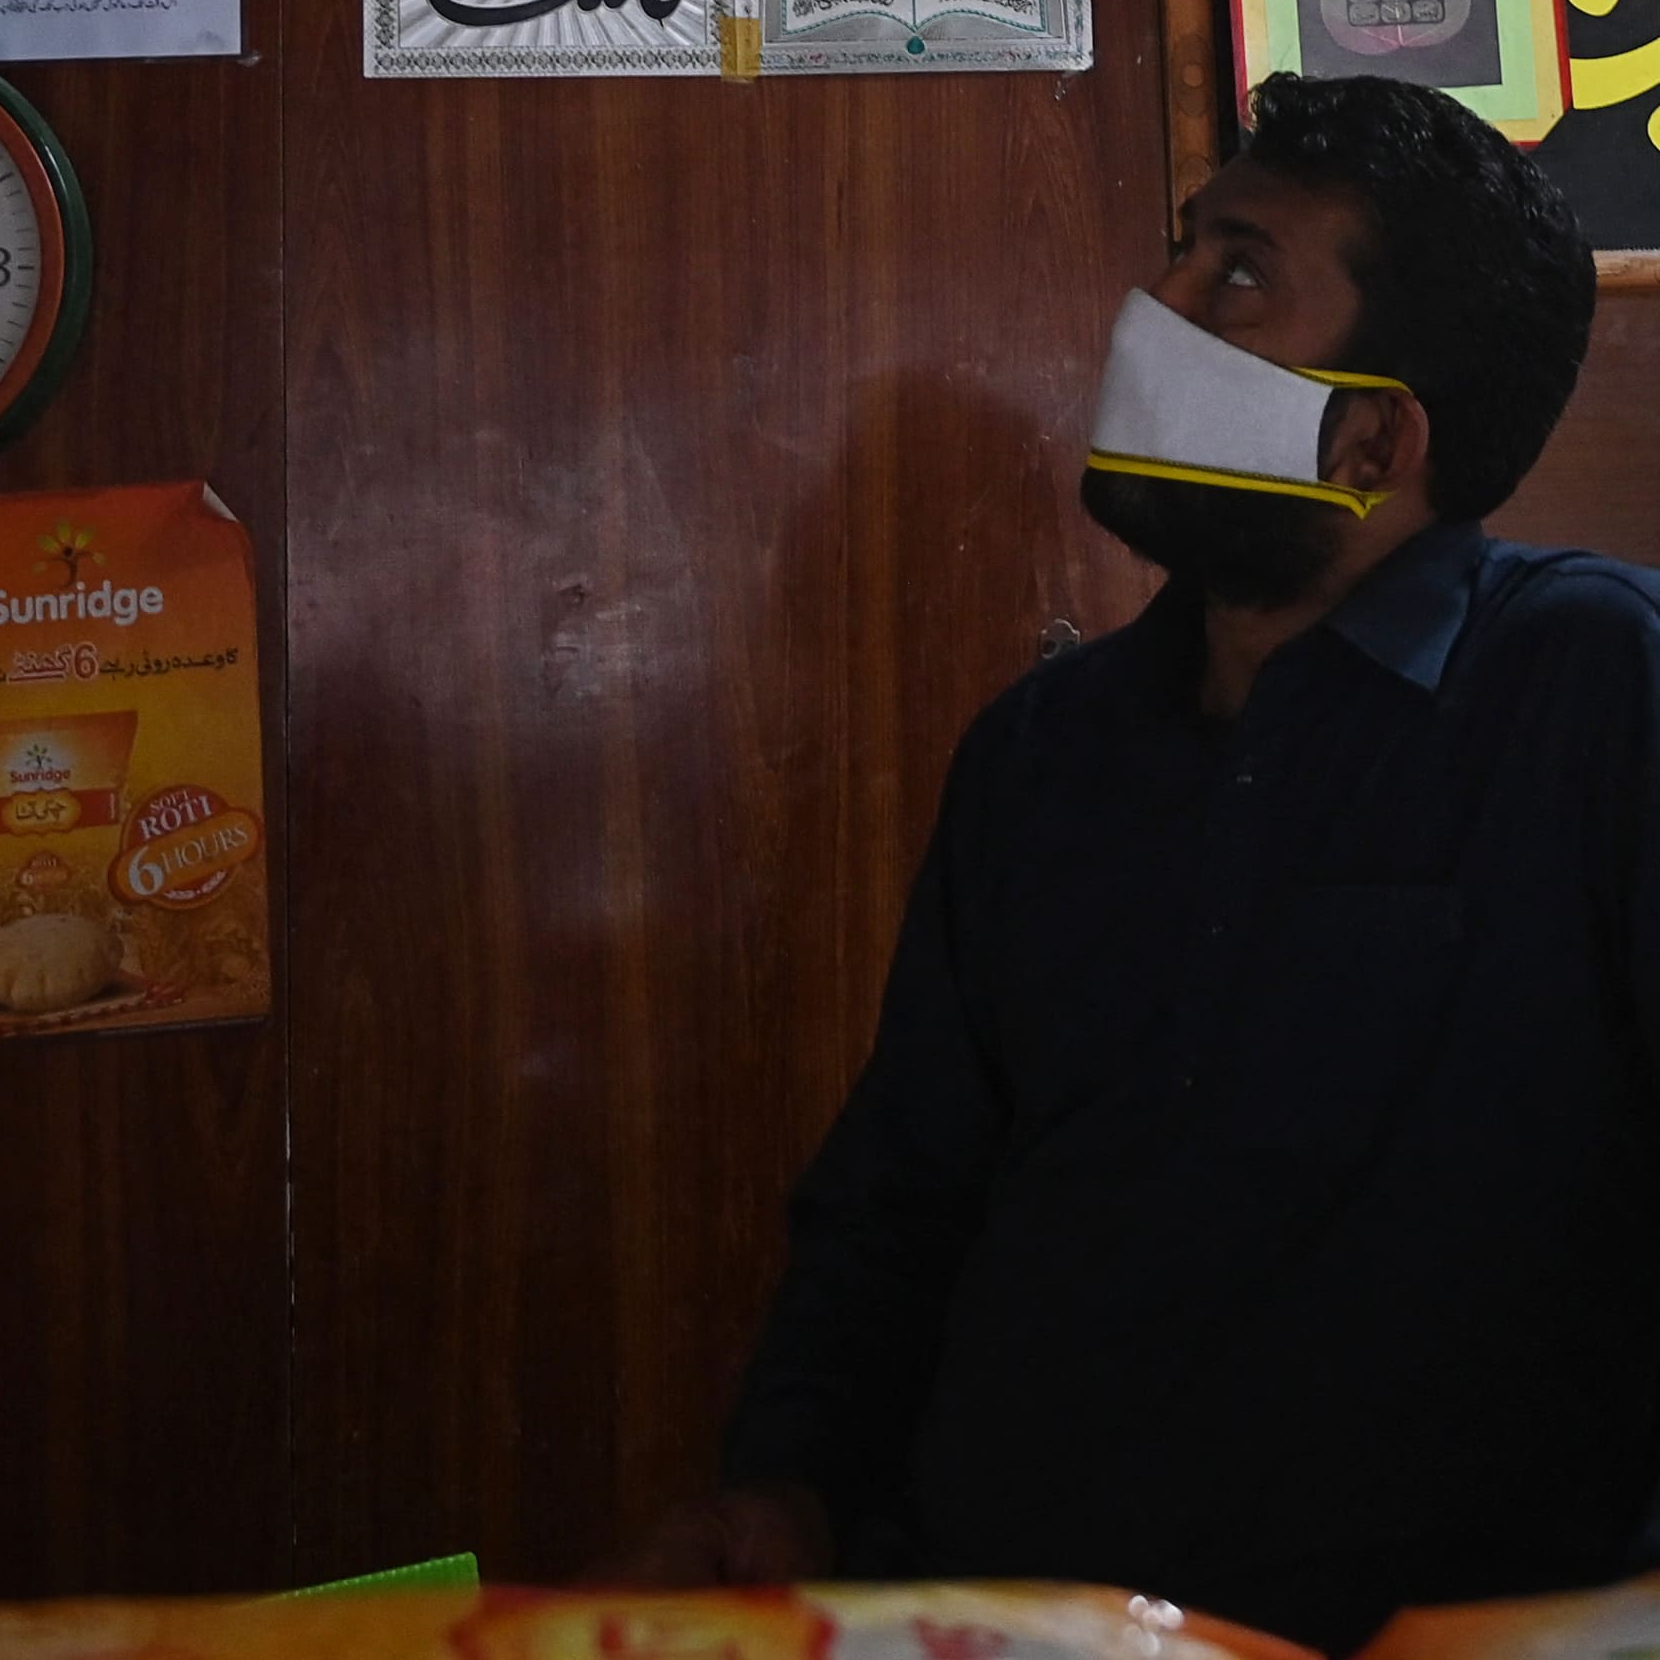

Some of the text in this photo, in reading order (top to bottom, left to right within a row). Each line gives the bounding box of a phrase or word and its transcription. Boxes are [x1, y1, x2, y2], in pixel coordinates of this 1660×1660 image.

[73, 641, 100, 680] 6
[10, 769, 71, 784] Sunridge
[137, 795, 214, 841] ROTI
[128, 845, 166, 896] 6
[162, 826, 249, 875] HOURS
